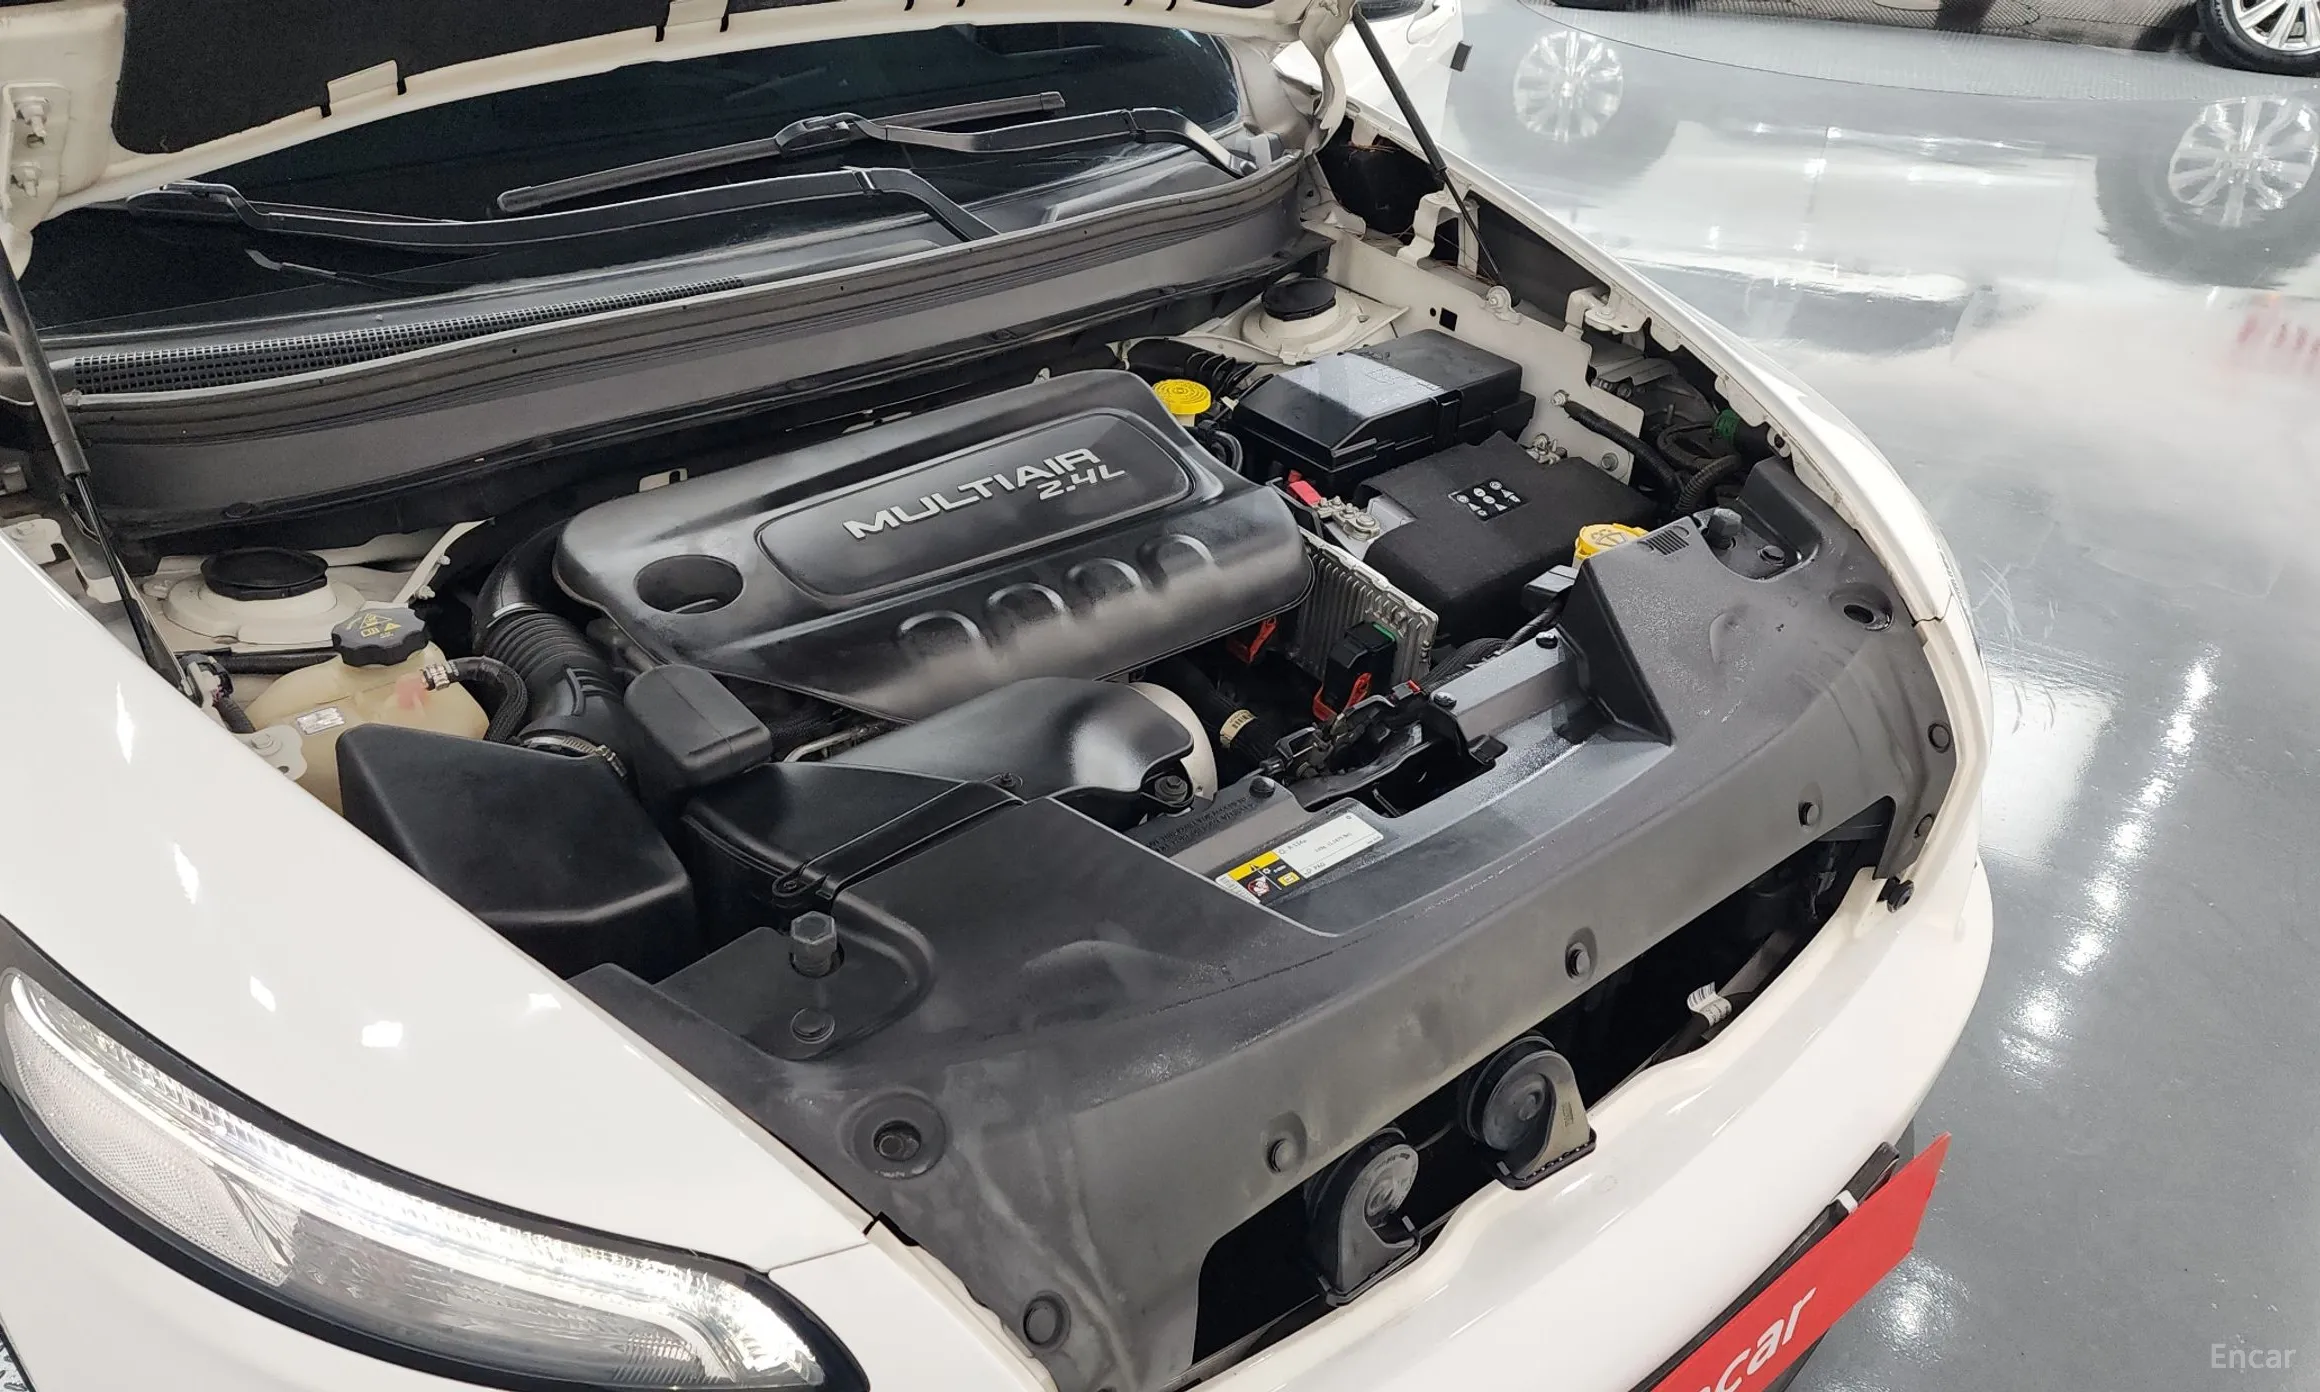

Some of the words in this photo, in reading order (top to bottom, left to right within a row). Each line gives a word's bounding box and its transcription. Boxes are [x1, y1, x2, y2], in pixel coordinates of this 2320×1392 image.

[843, 448, 1100, 539] MULTIAIR
[1037, 464, 1125, 501] 2.4L
[1698, 1287, 1817, 1392] car
